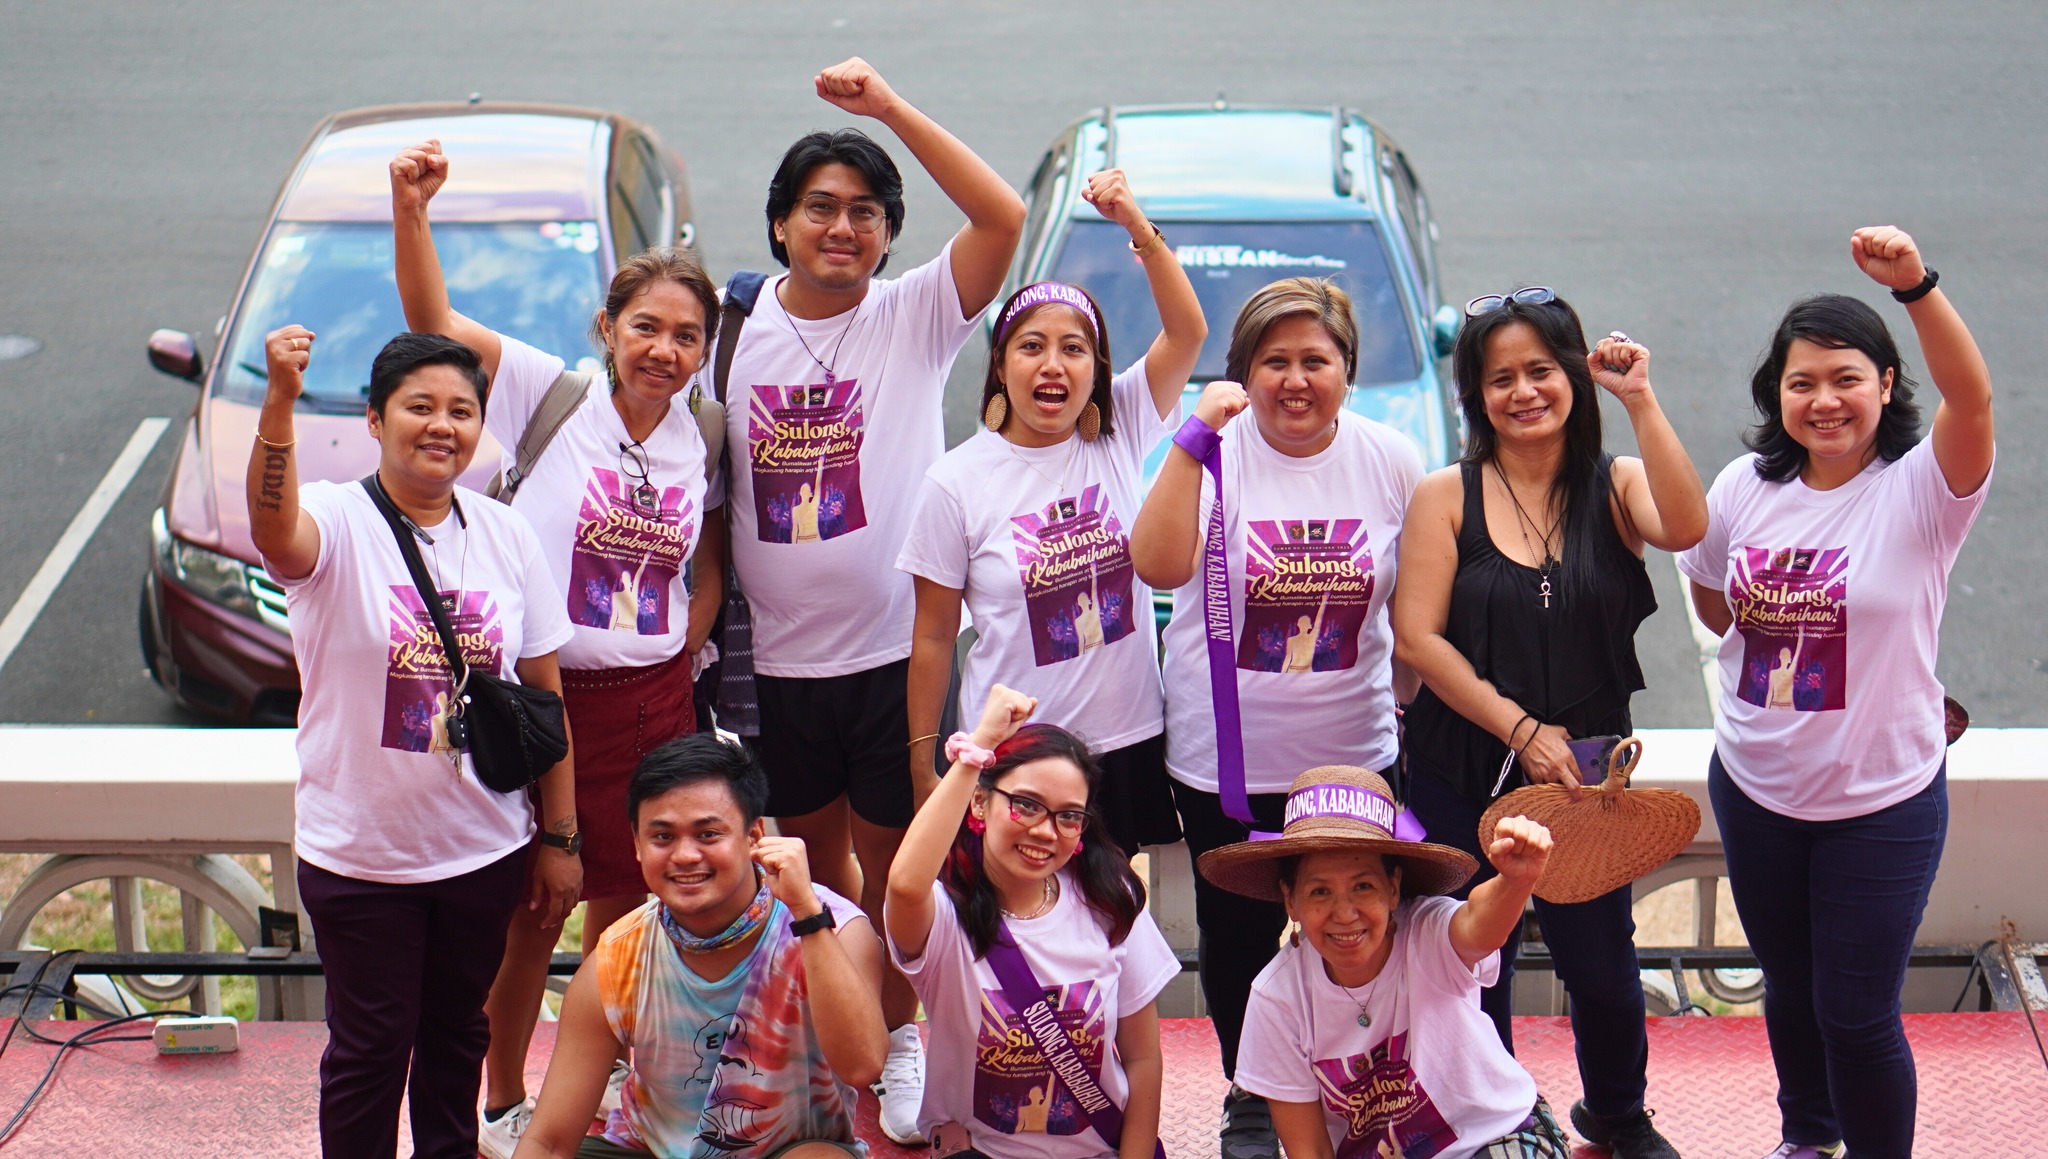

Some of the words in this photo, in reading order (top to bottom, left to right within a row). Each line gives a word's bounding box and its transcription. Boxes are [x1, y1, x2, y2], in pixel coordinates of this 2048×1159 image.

[1176, 250, 1278, 267] NISSAN
[773, 421, 851, 440] Sulong,
[754, 429, 860, 467] Kababaihan!
[579, 520, 689, 558] Kababaihan!
[606, 508, 685, 543] Sulong,
[1206, 498, 1224, 552] SULONG,
[608, 553, 628, 561] harapin
[1040, 526, 1114, 559] Sulong,
[1025, 531, 1124, 588] Kababaihan!
[1273, 554, 1362, 578] Sulong,
[1027, 585, 1059, 598] Magkaisang
[1058, 579, 1078, 590] harapin
[1078, 575, 1088, 584] ang
[1206, 553, 1232, 642] KABABAIHAN!
[1249, 570, 1370, 601] Kababaihan!
[1748, 582, 1833, 607] Sulong,
[1736, 599, 1844, 625] Kababaihan!
[415, 624, 492, 651] Sung,
[393, 641, 502, 672] Kababhan!
[389, 671, 423, 680] Magkaisang
[1317, 788, 1394, 834] KABABAIHAN!
[1006, 1028, 1092, 1047] Sug,
[980, 1036, 1103, 1071] Kababn!
[1023, 1000, 1068, 1058] SULONG,
[1050, 1048, 1111, 1114] KABABAIHAN!
[1346, 1075, 1408, 1112] Sulon
